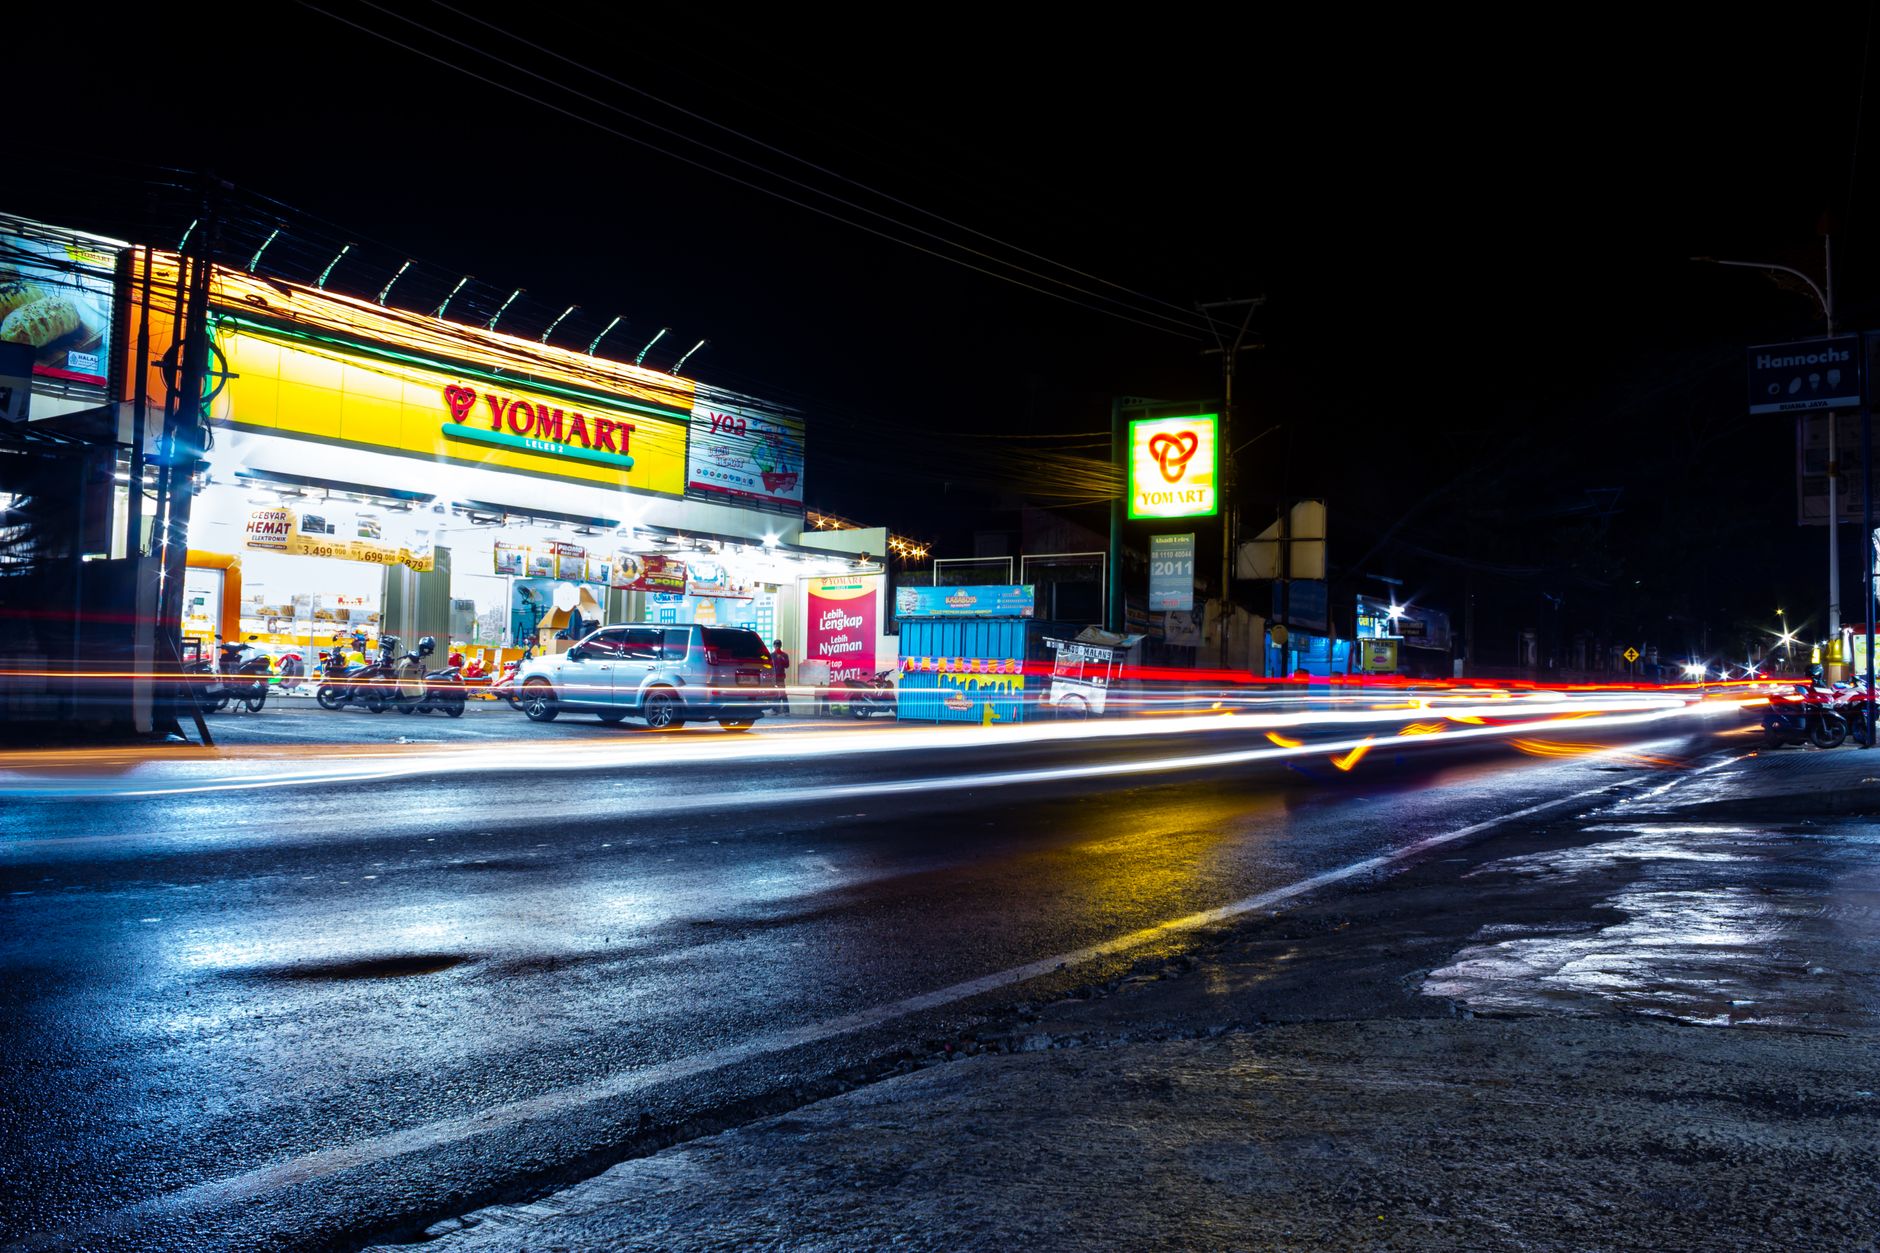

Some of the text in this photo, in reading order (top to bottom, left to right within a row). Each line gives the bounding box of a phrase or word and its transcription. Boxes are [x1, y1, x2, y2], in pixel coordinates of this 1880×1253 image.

[1757, 347, 1850, 369] Hannochs
[485, 394, 636, 455] YOMART
[558, 446, 564, 454] 2
[1142, 489, 1206, 506] YOMART
[246, 521, 292, 535] HEMAT
[823, 608, 844, 620] Lebih
[819, 614, 863, 631] Lengkap
[830, 634, 848, 644] Lebih
[819, 640, 863, 657] Nyaman
[830, 668, 860, 682] EMAT!
